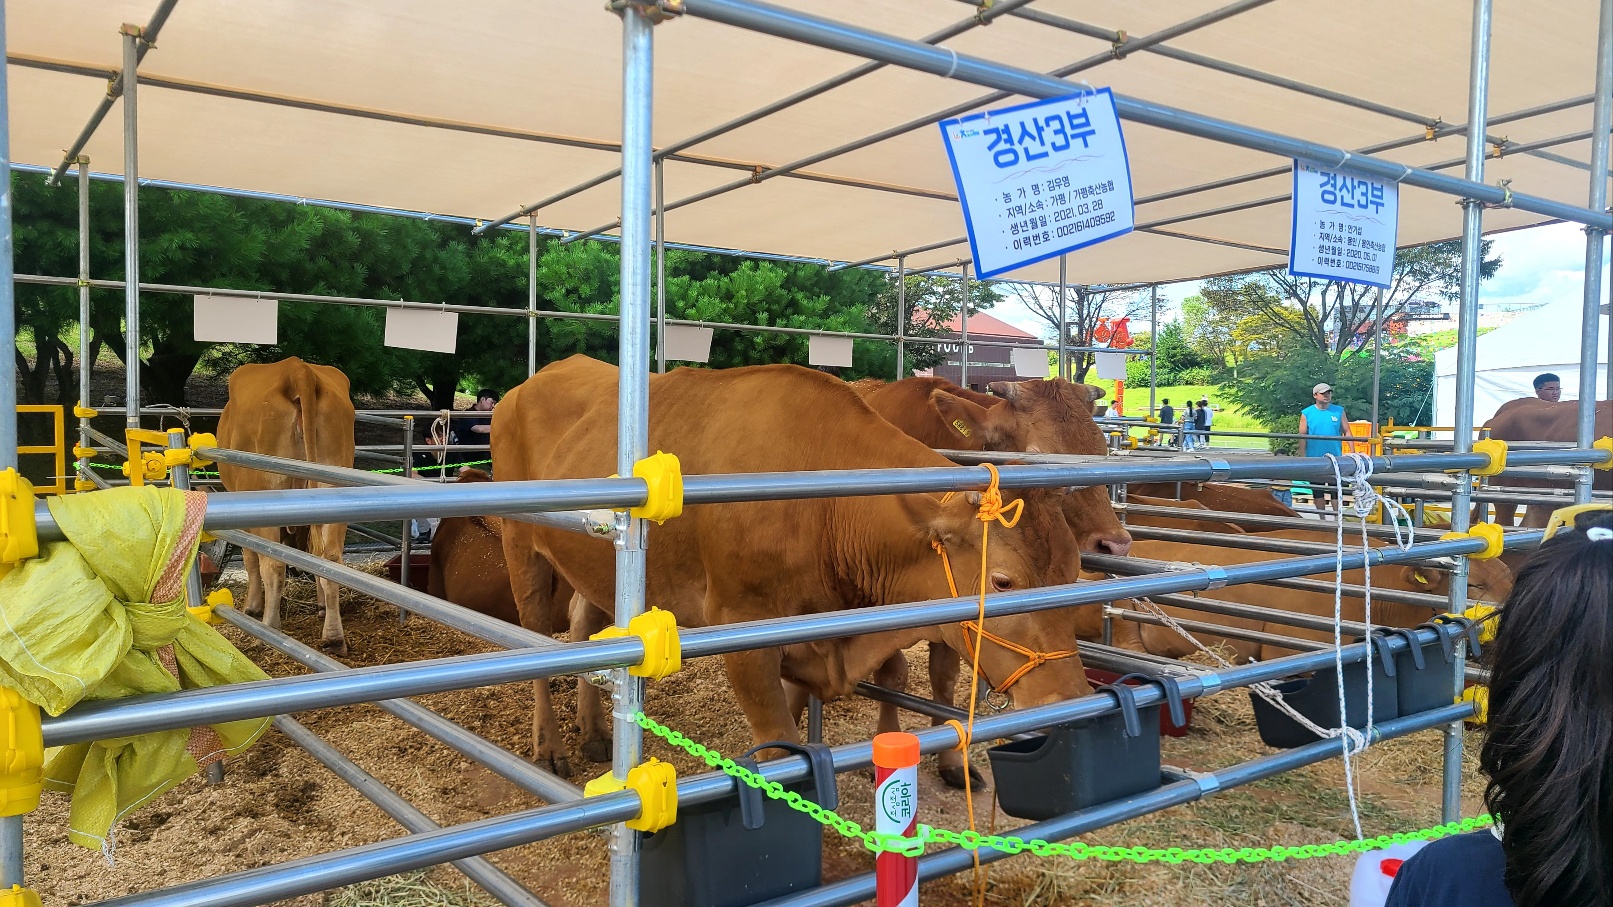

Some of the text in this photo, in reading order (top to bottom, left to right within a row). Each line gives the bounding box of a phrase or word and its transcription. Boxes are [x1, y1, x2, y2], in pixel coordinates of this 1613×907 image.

[983, 107, 1096, 169] 경산3부
[1046, 175, 1071, 192] 김우영
[1051, 193, 1066, 208] 가평
[1074, 179, 1115, 201] 가평축산농협
[1319, 171, 1385, 214] 경산3부
[1056, 211, 1116, 238] 002161409592
[901, 782, 912, 819] 코리아
